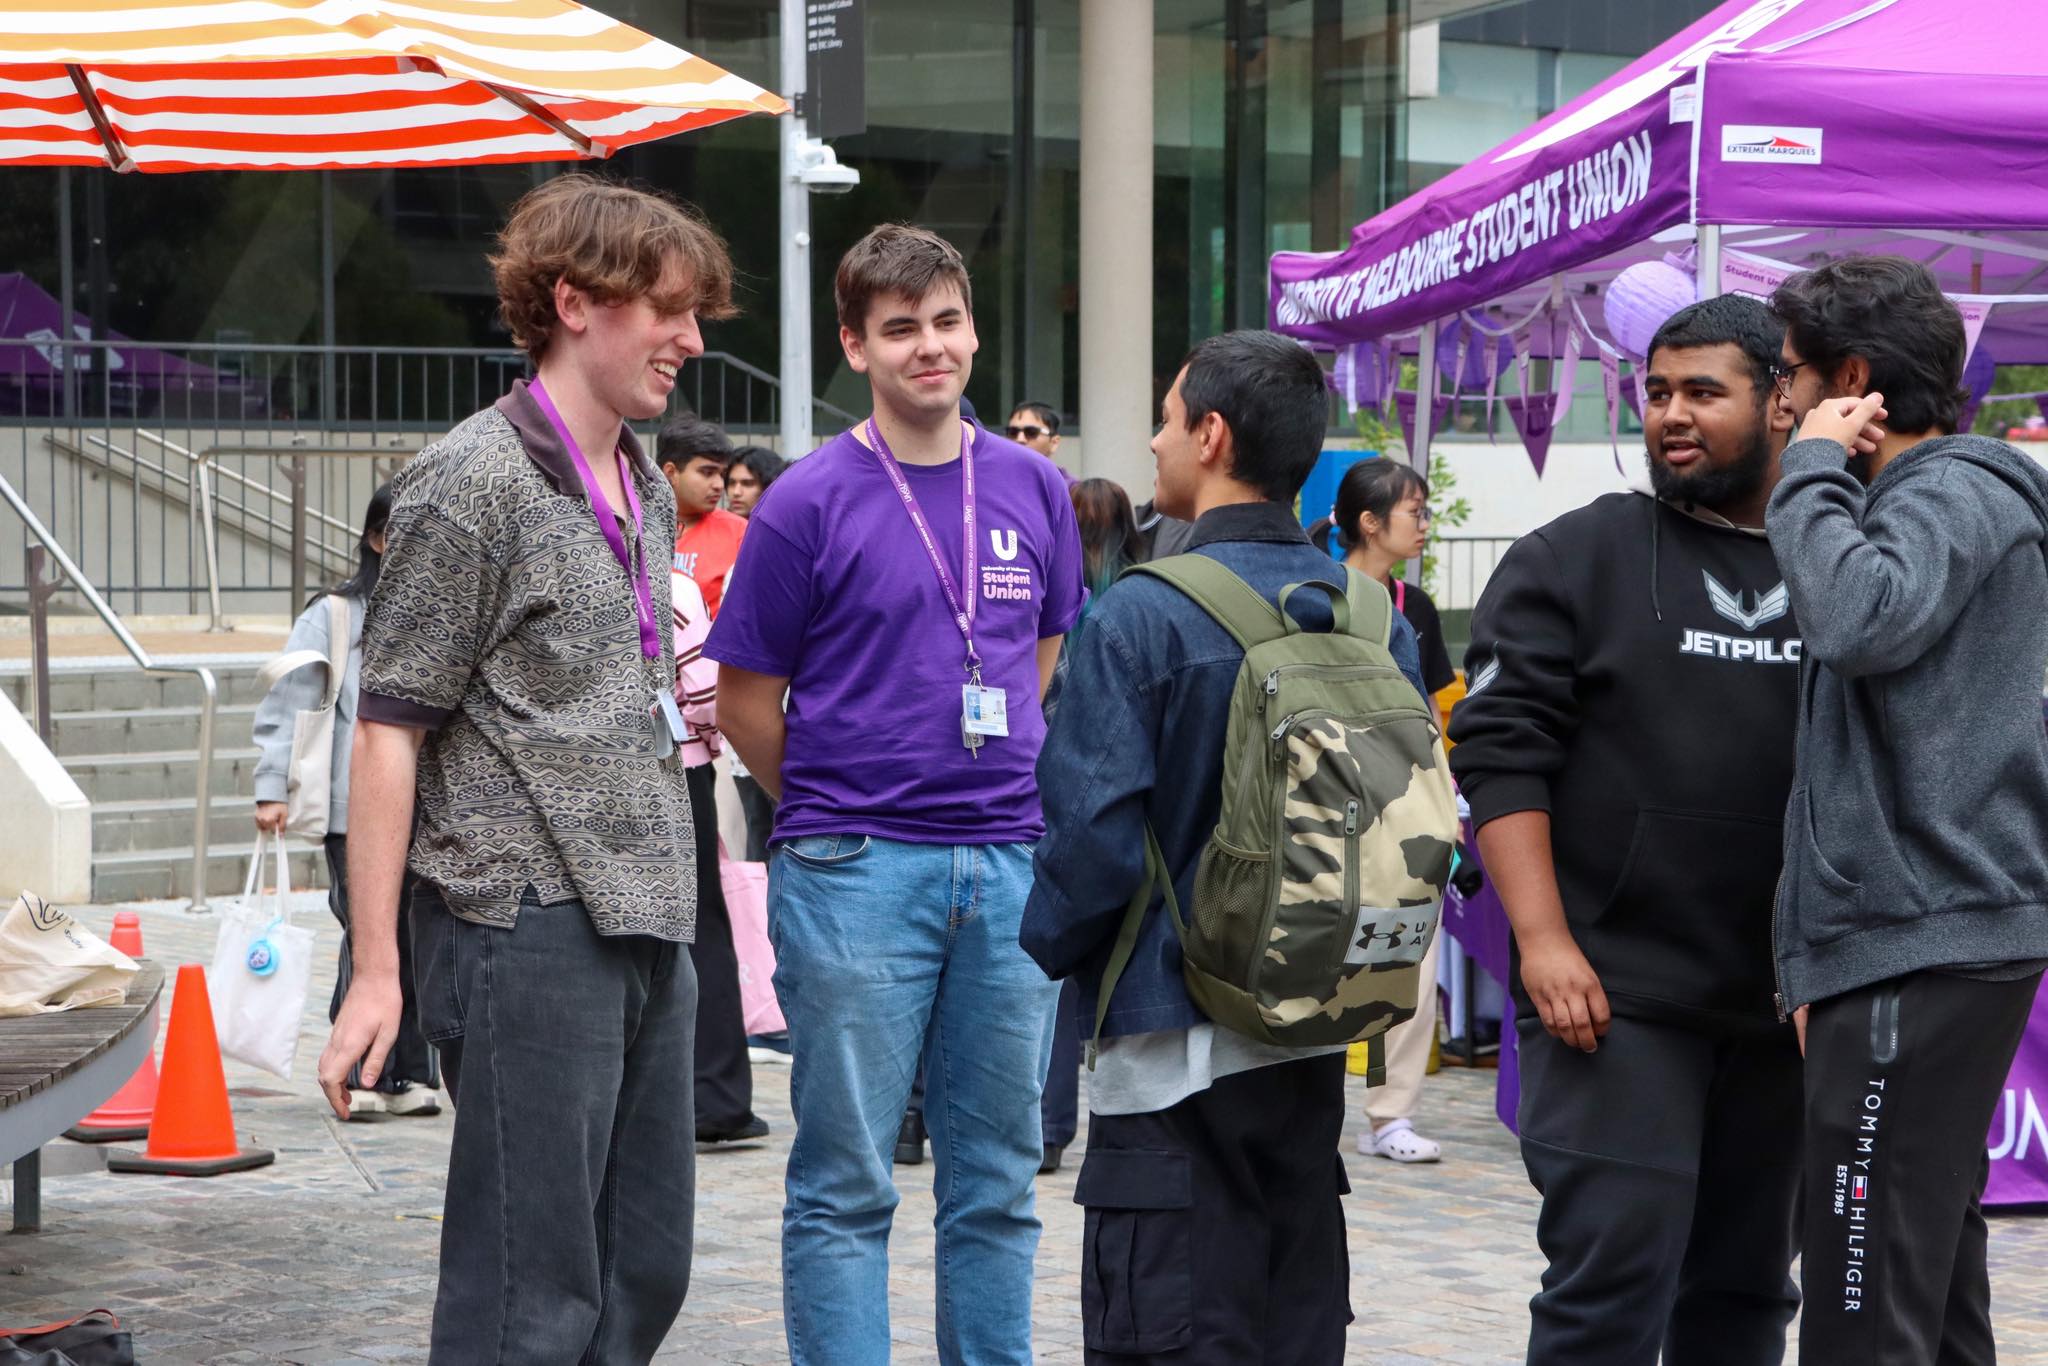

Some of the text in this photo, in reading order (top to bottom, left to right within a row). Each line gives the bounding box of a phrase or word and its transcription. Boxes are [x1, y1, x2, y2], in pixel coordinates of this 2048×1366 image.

[1727, 145, 1816, 156] EXTREME MARQUEES
[1357, 218, 1468, 314] MELBOURNE
[1463, 169, 1564, 273] STUDENT
[1567, 129, 1652, 230] UNION
[1725, 264, 1765, 283] Student
[982, 572, 1031, 585] Student
[983, 583, 1031, 601] Union
[1834, 1164, 1848, 1215] EST.1985
[1844, 1078, 1885, 1311] TOMMY HILFIGER
